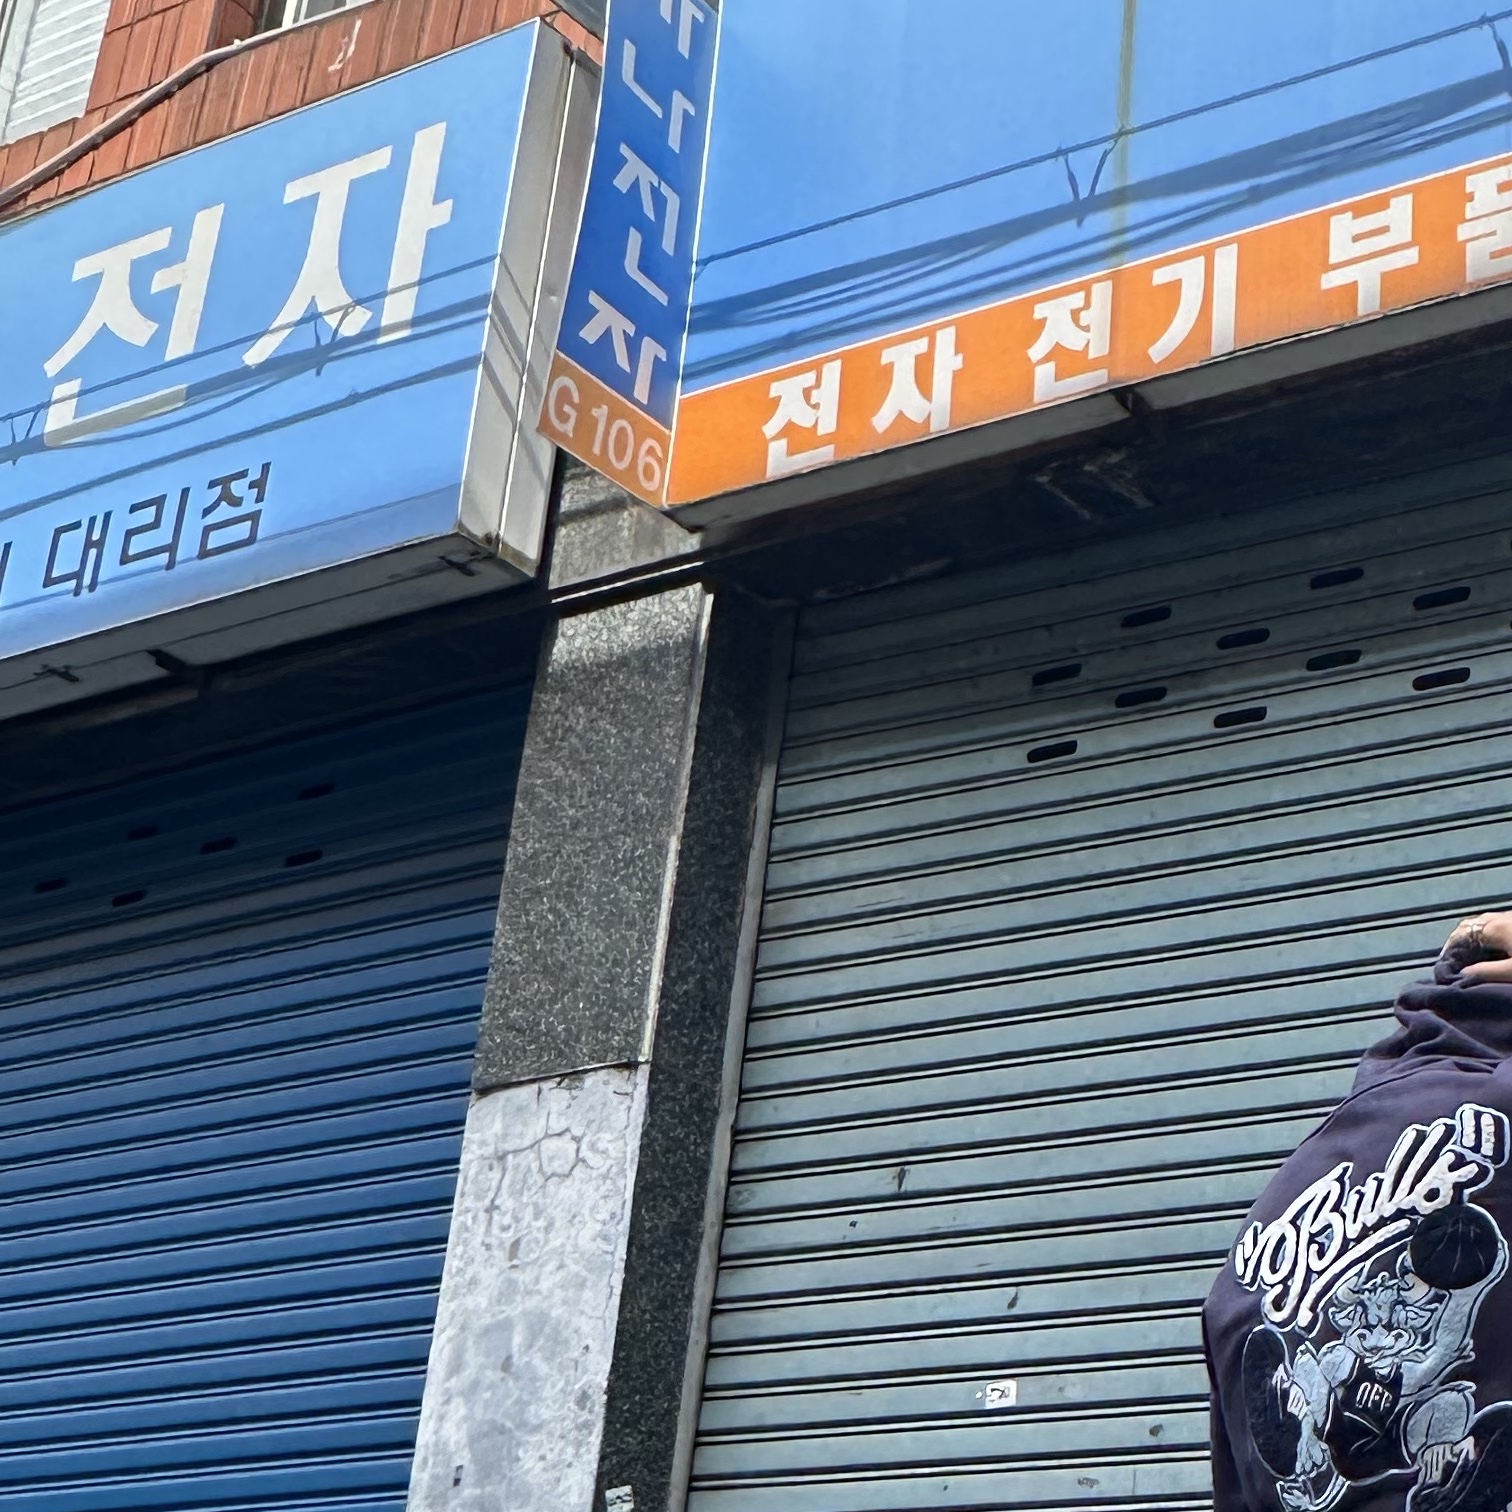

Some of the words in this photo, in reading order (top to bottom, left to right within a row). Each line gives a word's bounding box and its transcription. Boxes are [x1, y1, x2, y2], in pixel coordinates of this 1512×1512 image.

[45, 121, 453, 447] 전자
[761, 325, 963, 479] 전자
[1027, 243, 1238, 403] 전기
[42, 462, 271, 597] 대리점
